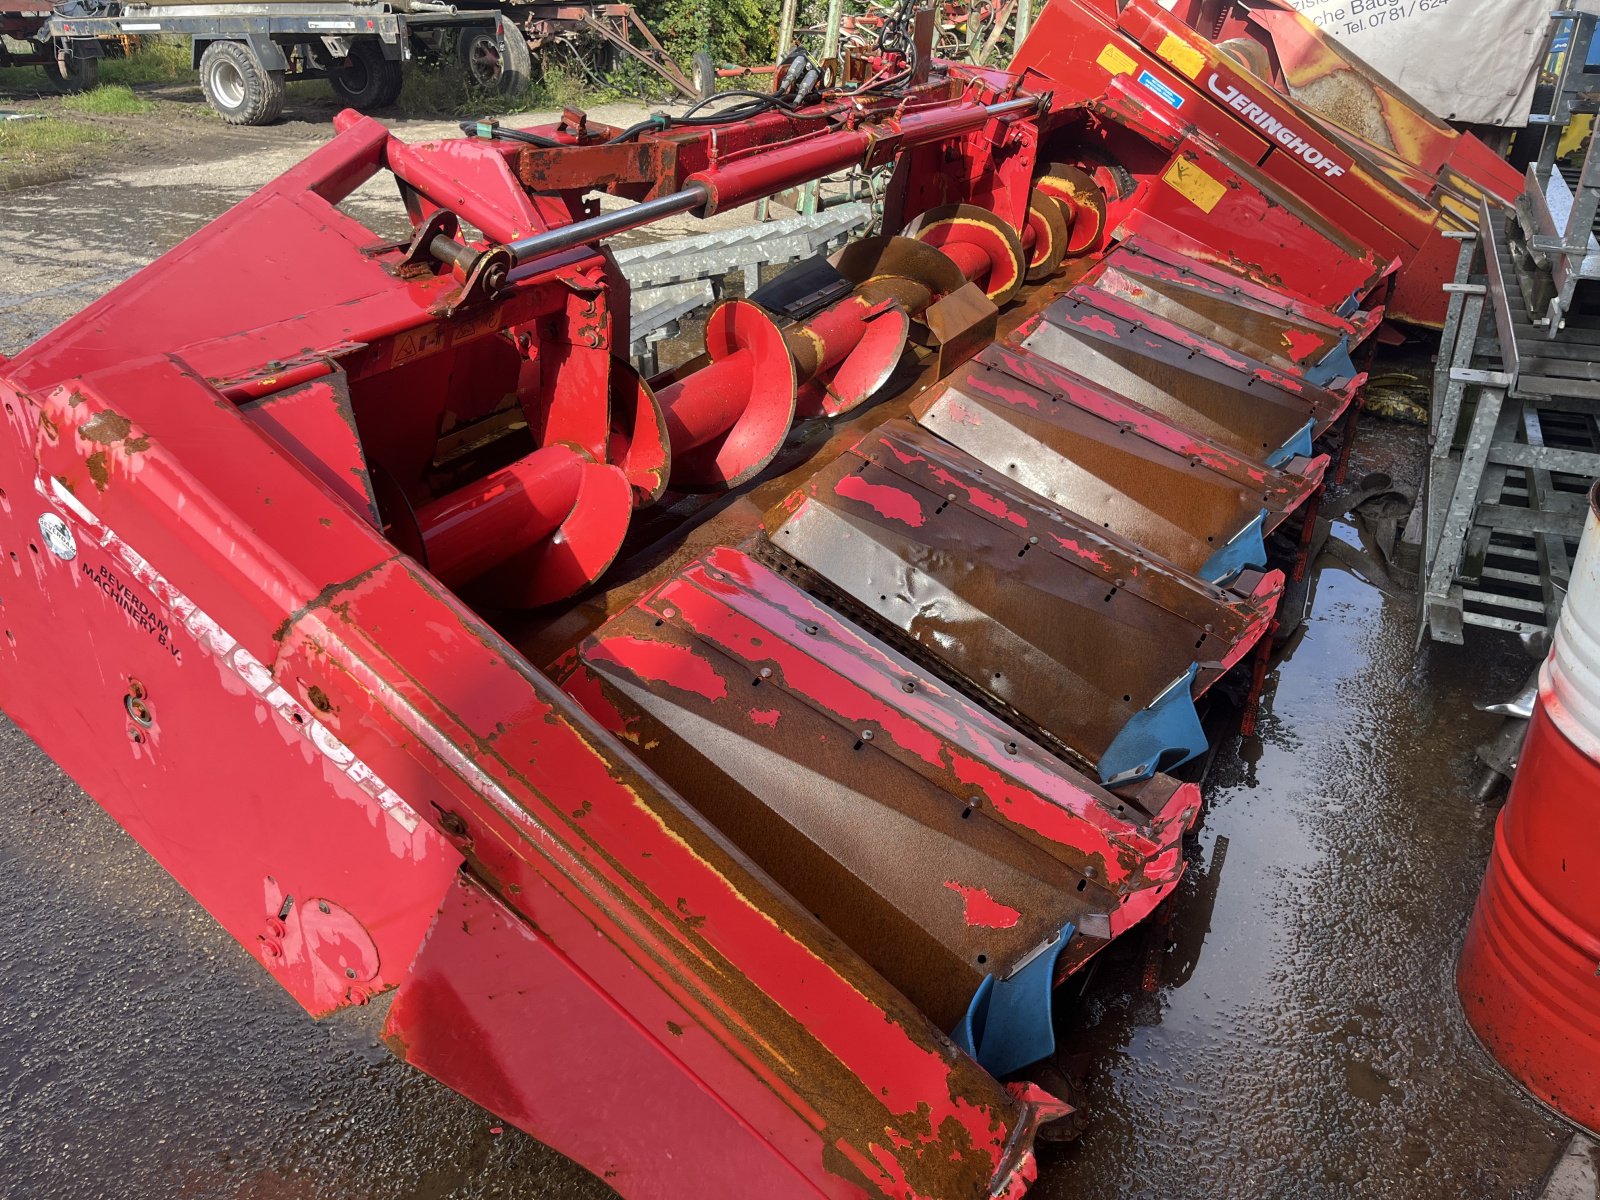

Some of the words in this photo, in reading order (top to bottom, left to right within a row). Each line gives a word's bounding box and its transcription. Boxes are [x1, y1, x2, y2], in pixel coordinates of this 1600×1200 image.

[1343, 19, 1367, 35] Tel.
[1207, 72, 1346, 177] GERINGHOFF
[82, 562, 156, 635] MACHINERY
[99, 564, 170, 636] BEVERDAM
